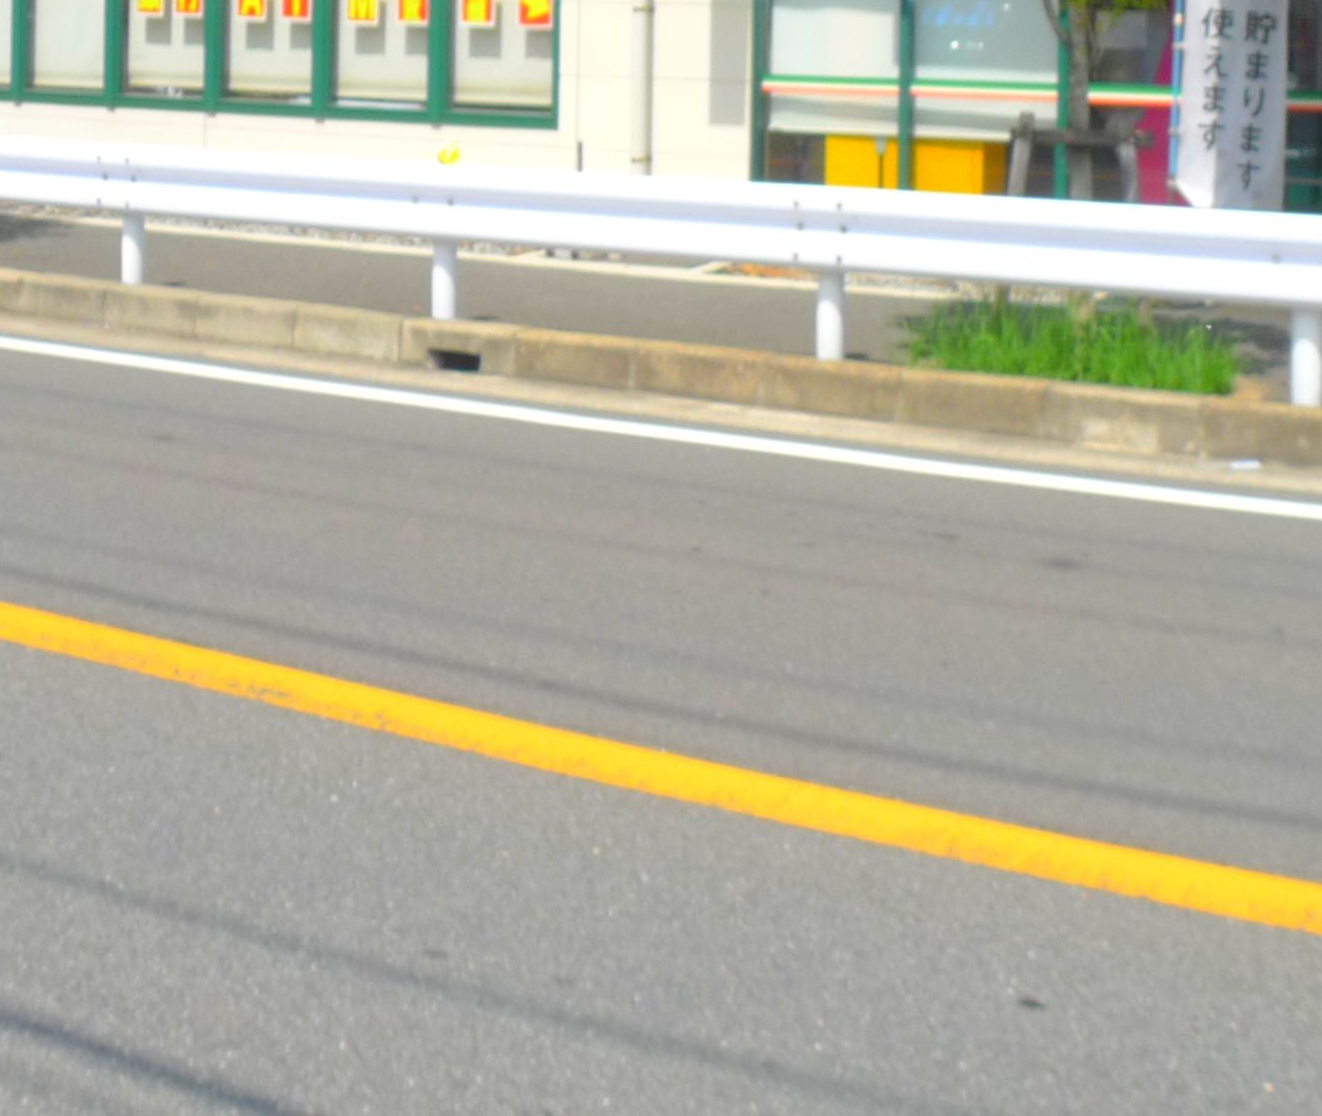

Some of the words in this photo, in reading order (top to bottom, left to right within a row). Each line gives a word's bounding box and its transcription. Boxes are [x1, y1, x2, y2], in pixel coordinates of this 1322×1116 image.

[1197, 7, 1234, 152] 使えます
[1239, 8, 1277, 191] 貯まります
